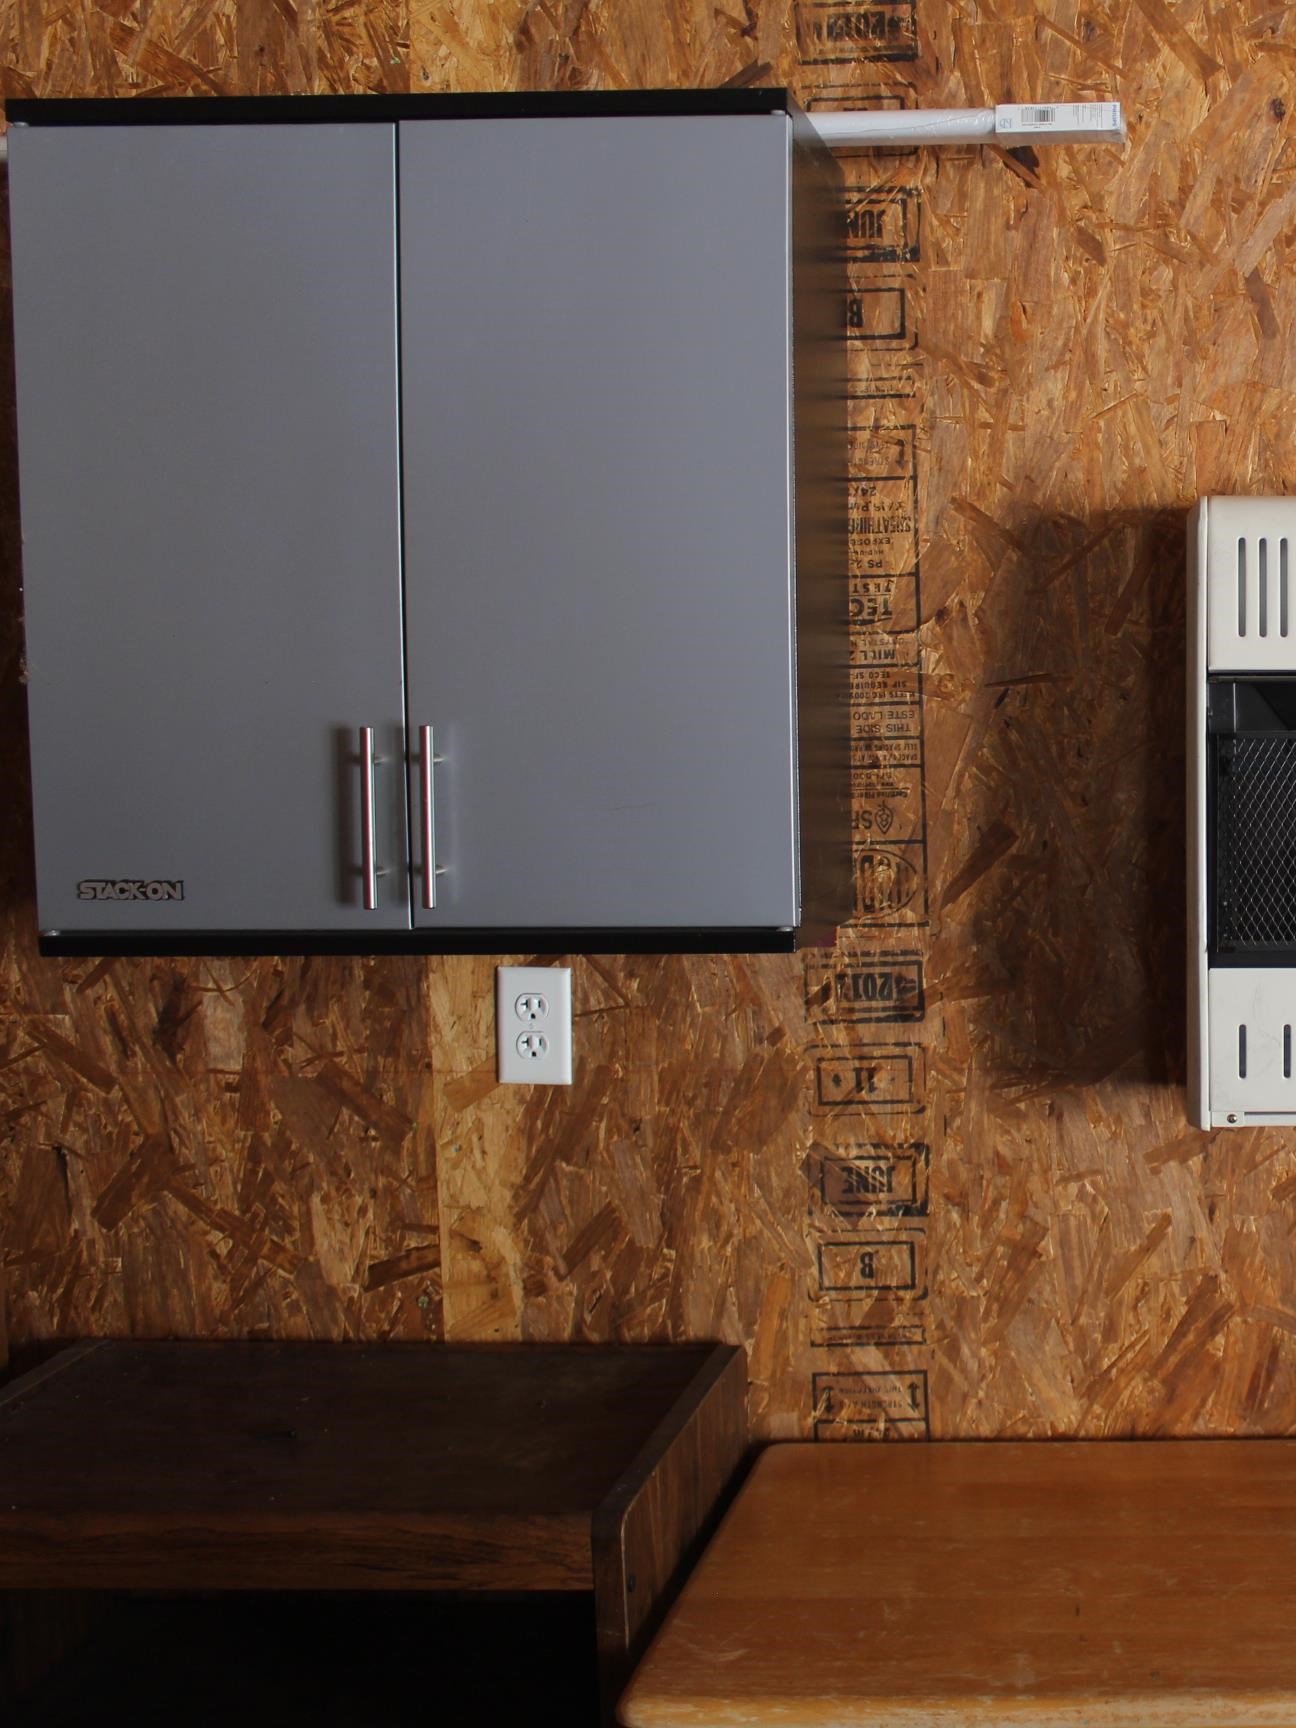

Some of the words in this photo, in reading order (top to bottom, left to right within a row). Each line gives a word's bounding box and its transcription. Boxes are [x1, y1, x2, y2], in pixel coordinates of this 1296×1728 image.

[847, 210, 885, 239] JUN
[848, 299, 863, 328] B
[867, 560, 883, 568] PS
[851, 582, 892, 594] TEST
[849, 597, 892, 617] TEC
[859, 650, 896, 661] MILL
[852, 711, 883, 720] LADO
[887, 710, 915, 719] ESTE
[855, 724, 881, 734] SIDE
[886, 723, 911, 733] THIS
[851, 810, 872, 830] SF
[79, 880, 184, 901] STACK-ON
[841, 1166, 895, 1194] JUNE
[859, 1252, 874, 1279] B
